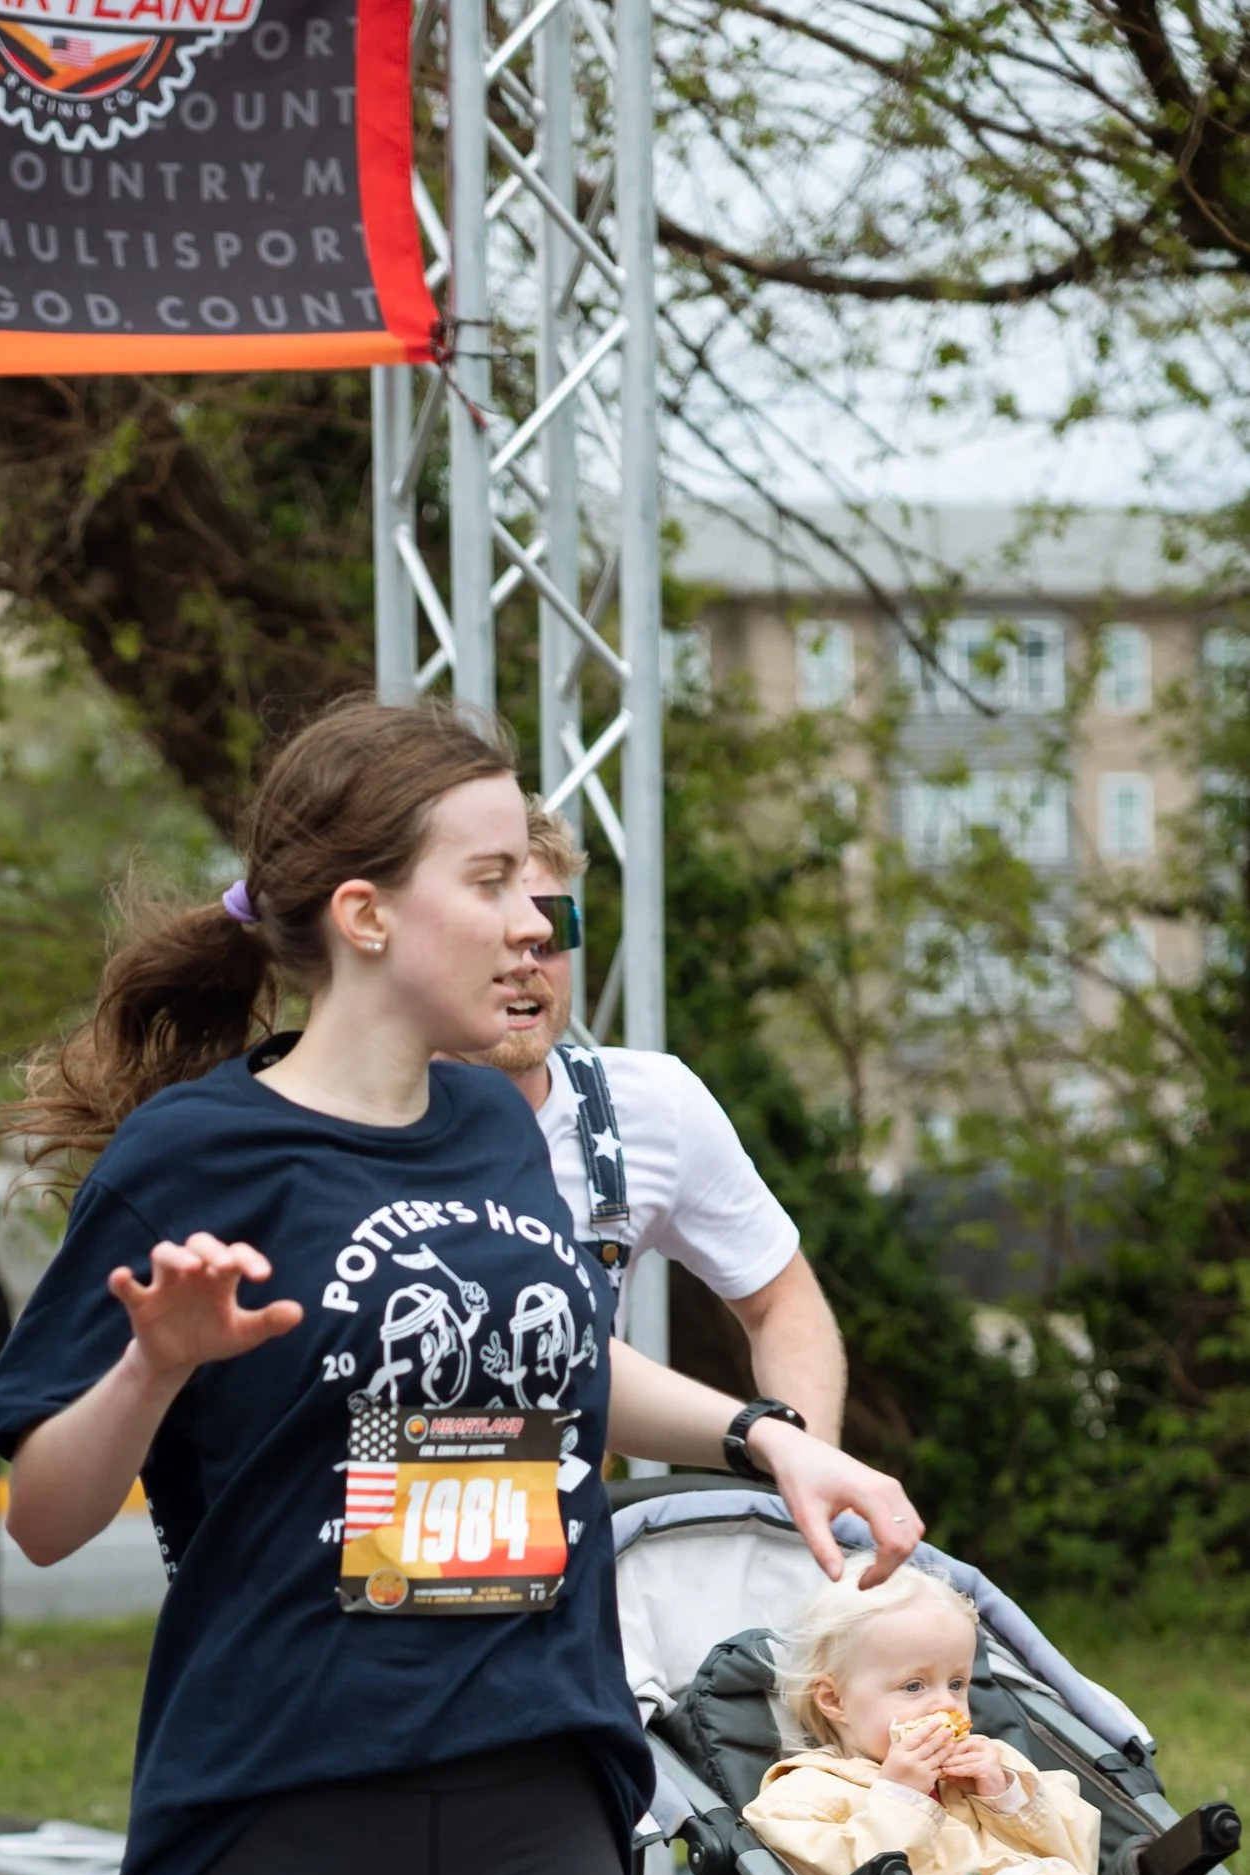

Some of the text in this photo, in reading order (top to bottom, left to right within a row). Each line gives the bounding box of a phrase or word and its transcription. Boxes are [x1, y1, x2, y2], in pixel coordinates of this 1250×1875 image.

[322, 1200, 478, 1313] POTTER'S
[322, 1351, 356, 1382] 20
[401, 1478, 529, 1563] 1984
